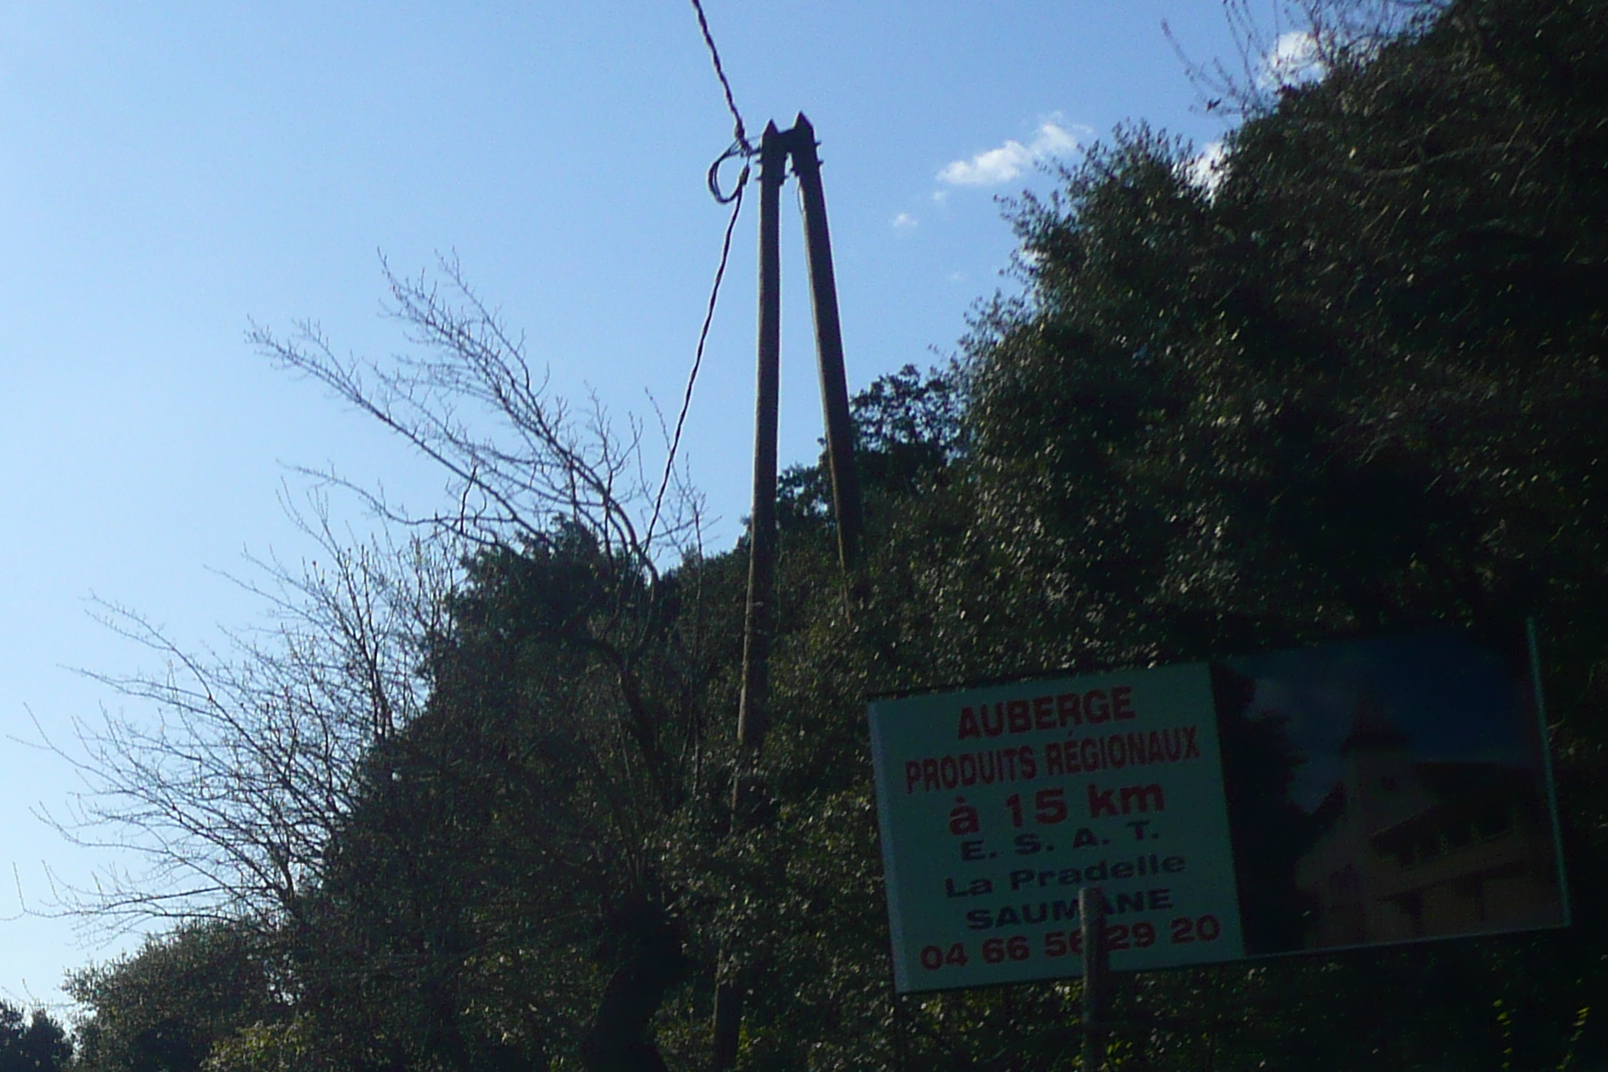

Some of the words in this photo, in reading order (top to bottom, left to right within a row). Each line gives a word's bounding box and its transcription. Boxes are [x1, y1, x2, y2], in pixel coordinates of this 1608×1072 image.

[958, 686, 1136, 740] AUBERGE
[905, 745, 1037, 794] PRODUITS
[1045, 725, 1201, 776] RÉGIONAUX
[949, 796, 981, 836] à
[1006, 788, 1068, 828] 15
[1088, 783, 1165, 819] km
[945, 877, 992, 898] La
[1009, 853, 1186, 890] Pradelle
[920, 942, 969, 970] 04
[982, 935, 1030, 964] 66
[1105, 921, 1156, 951] 29
[1170, 914, 1221, 944] 20
